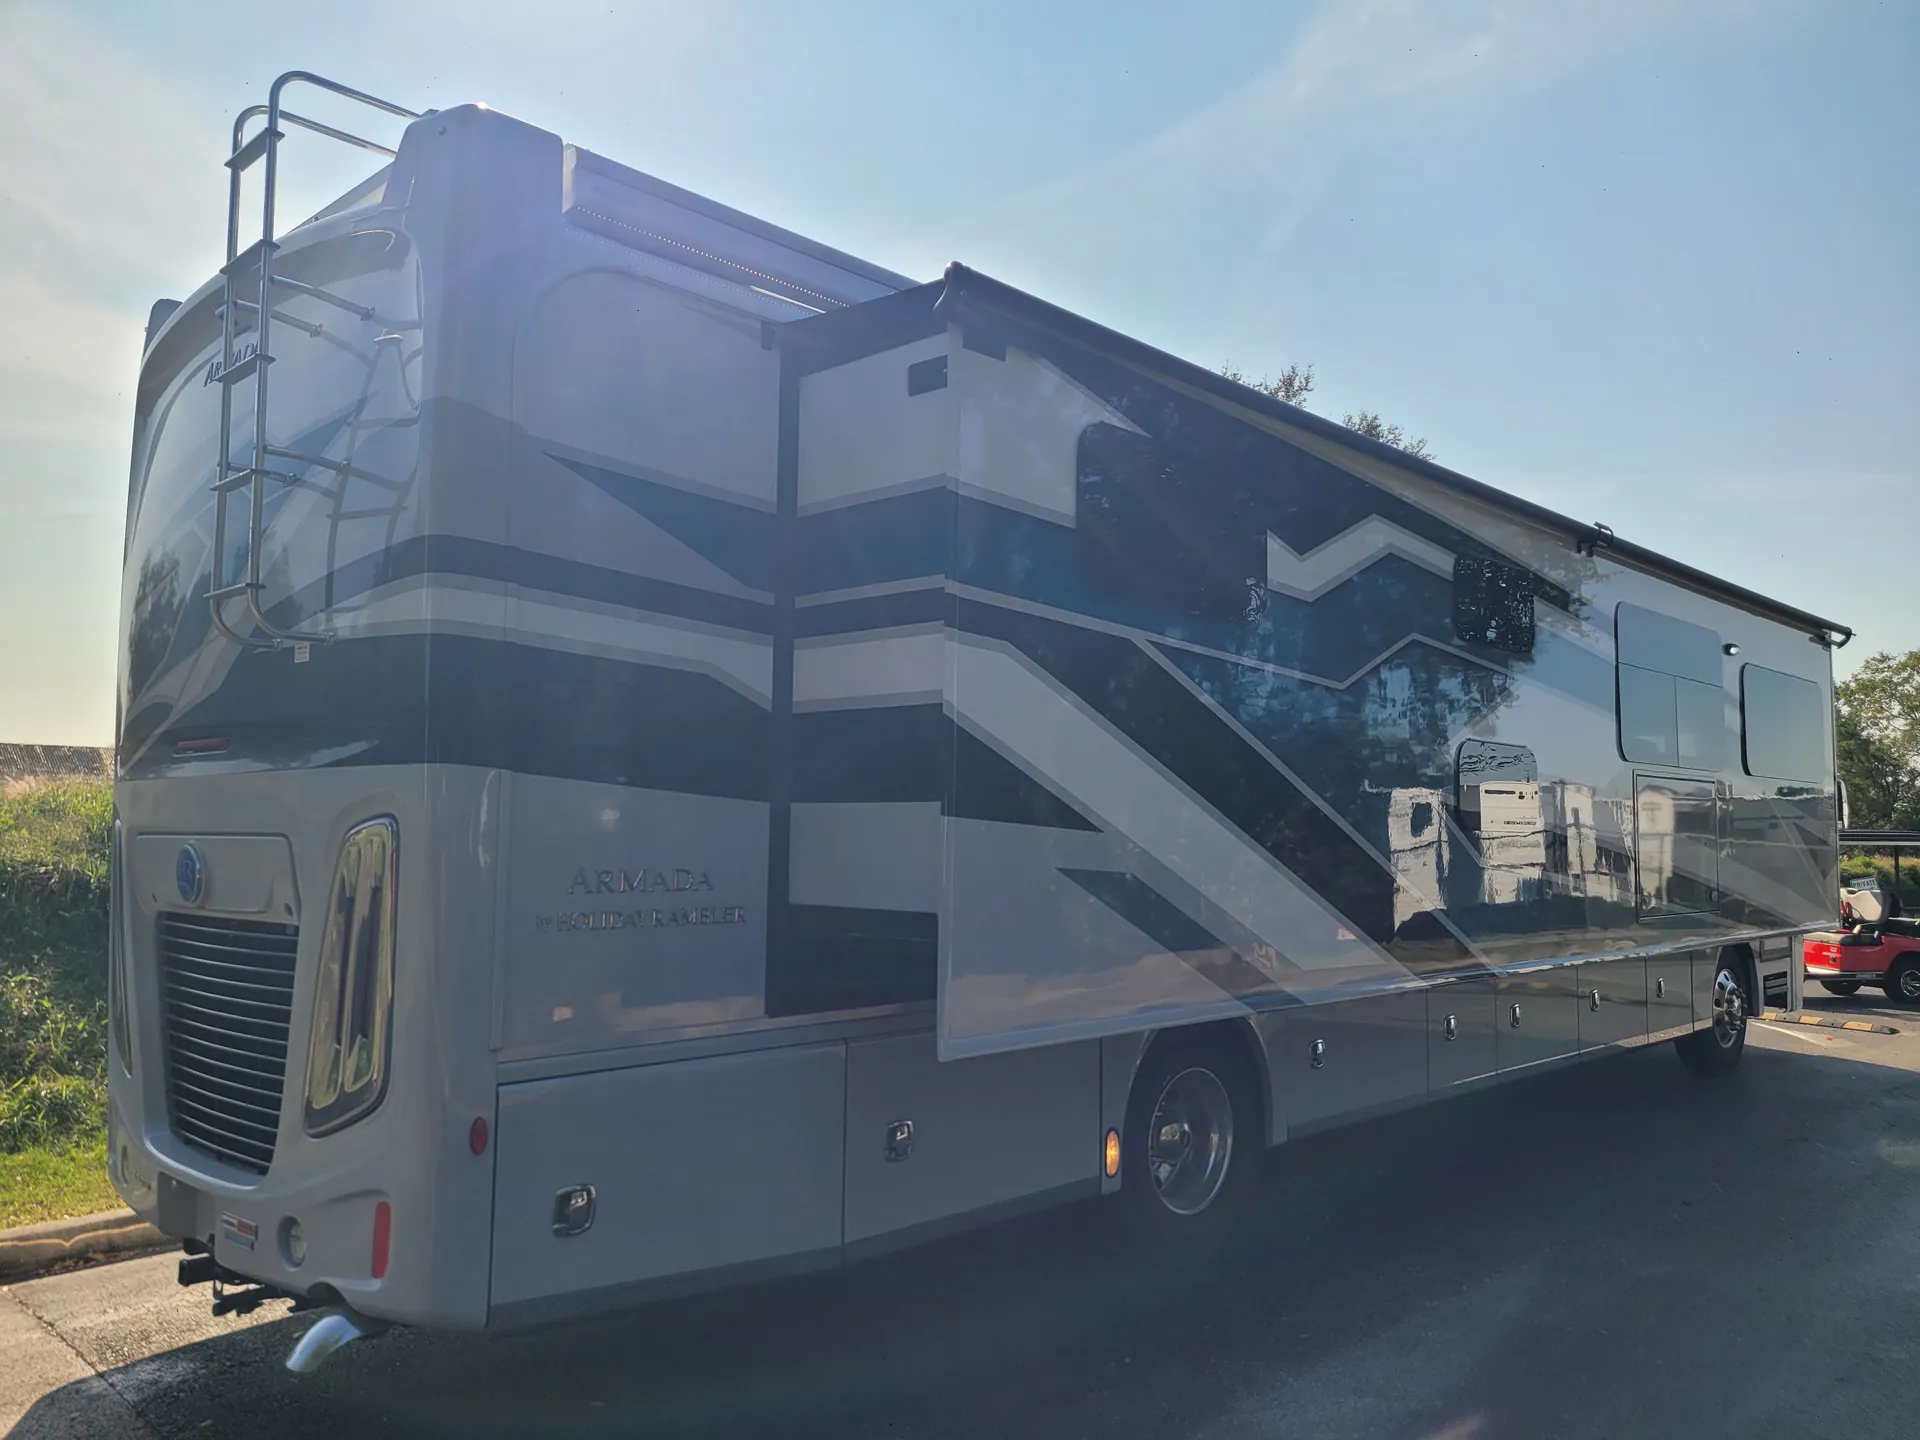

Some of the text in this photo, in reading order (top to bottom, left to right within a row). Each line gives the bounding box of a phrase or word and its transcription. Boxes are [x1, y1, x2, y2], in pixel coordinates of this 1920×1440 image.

[567, 866, 714, 894] ARMADA
[1852, 879, 1877, 888] PRIVATE
[556, 909, 650, 932] HOLIDAY
[651, 906, 747, 929] RAMBLER
